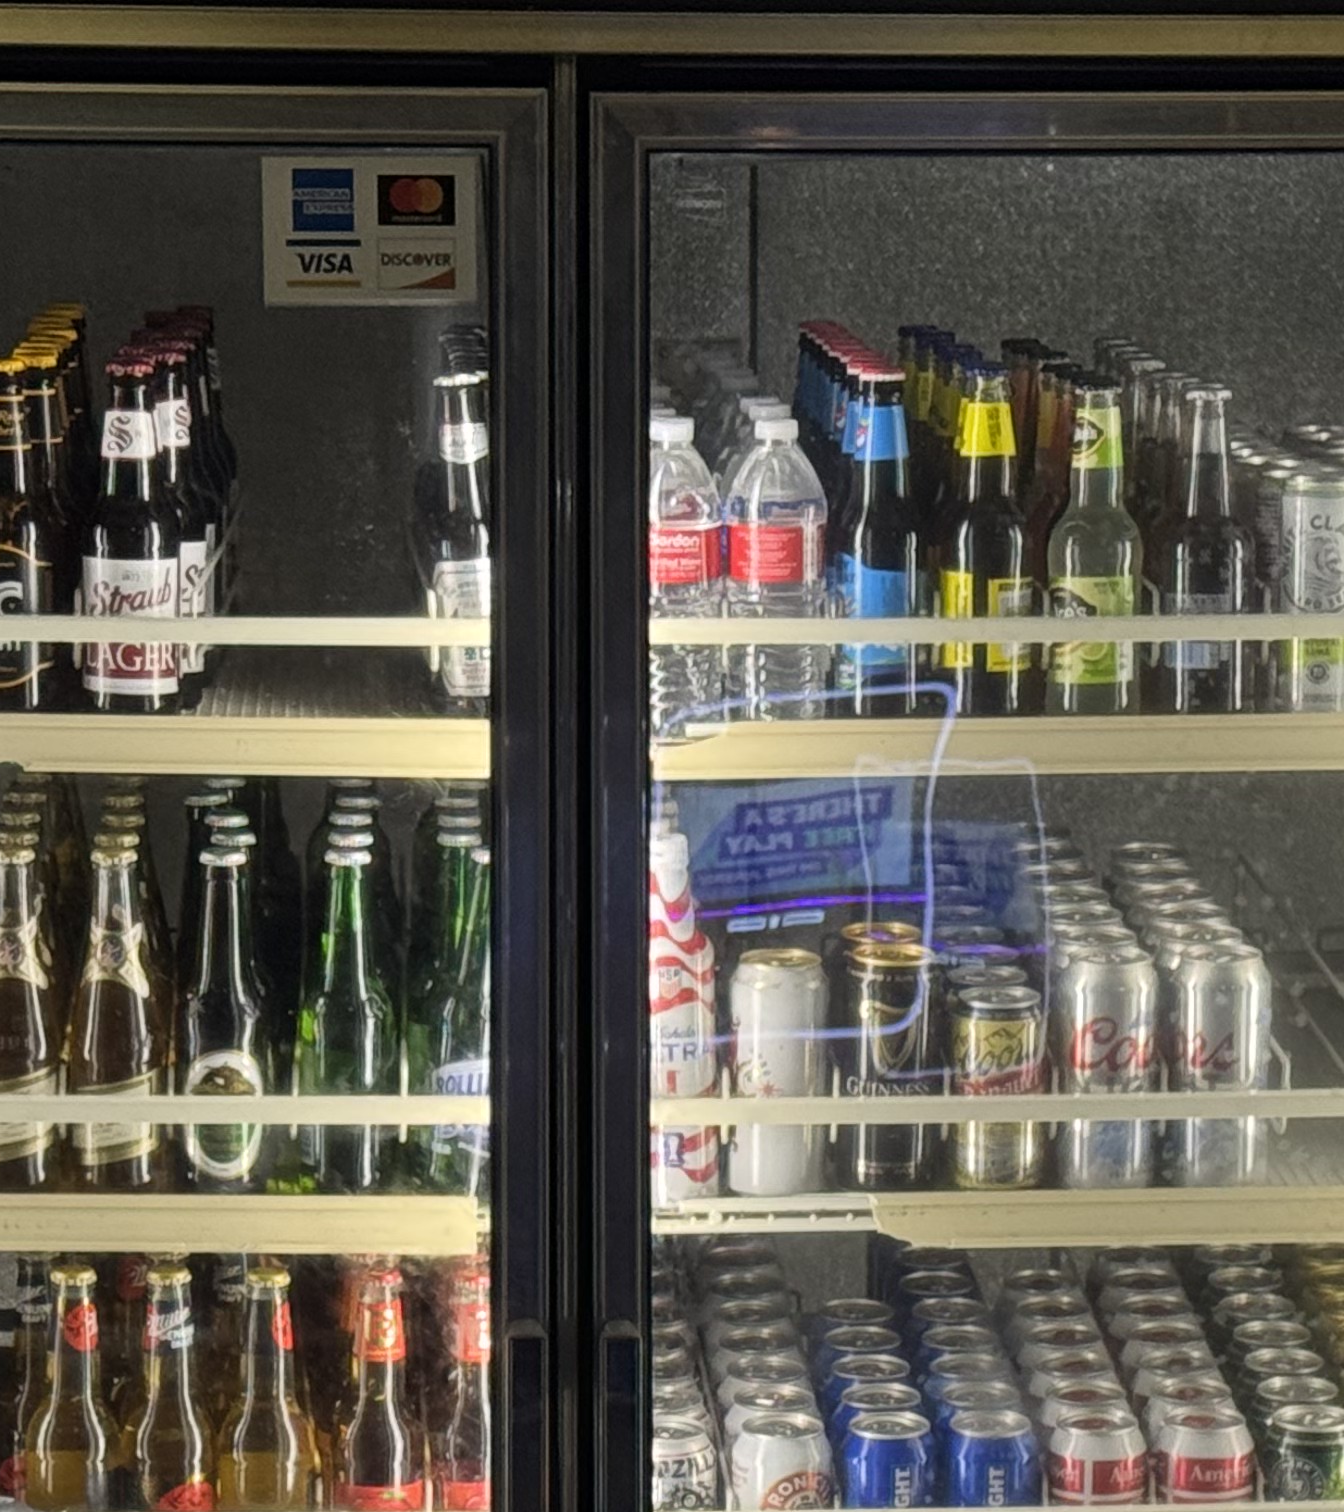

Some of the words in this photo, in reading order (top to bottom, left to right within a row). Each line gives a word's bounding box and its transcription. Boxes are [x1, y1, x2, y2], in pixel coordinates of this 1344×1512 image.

[296, 253, 353, 274] VISA
[381, 253, 452, 267] DISCOVER
[89, 567, 173, 616] Straub
[86, 642, 176, 672] LAGER
[846, 1075, 930, 1097] GUINNESS
